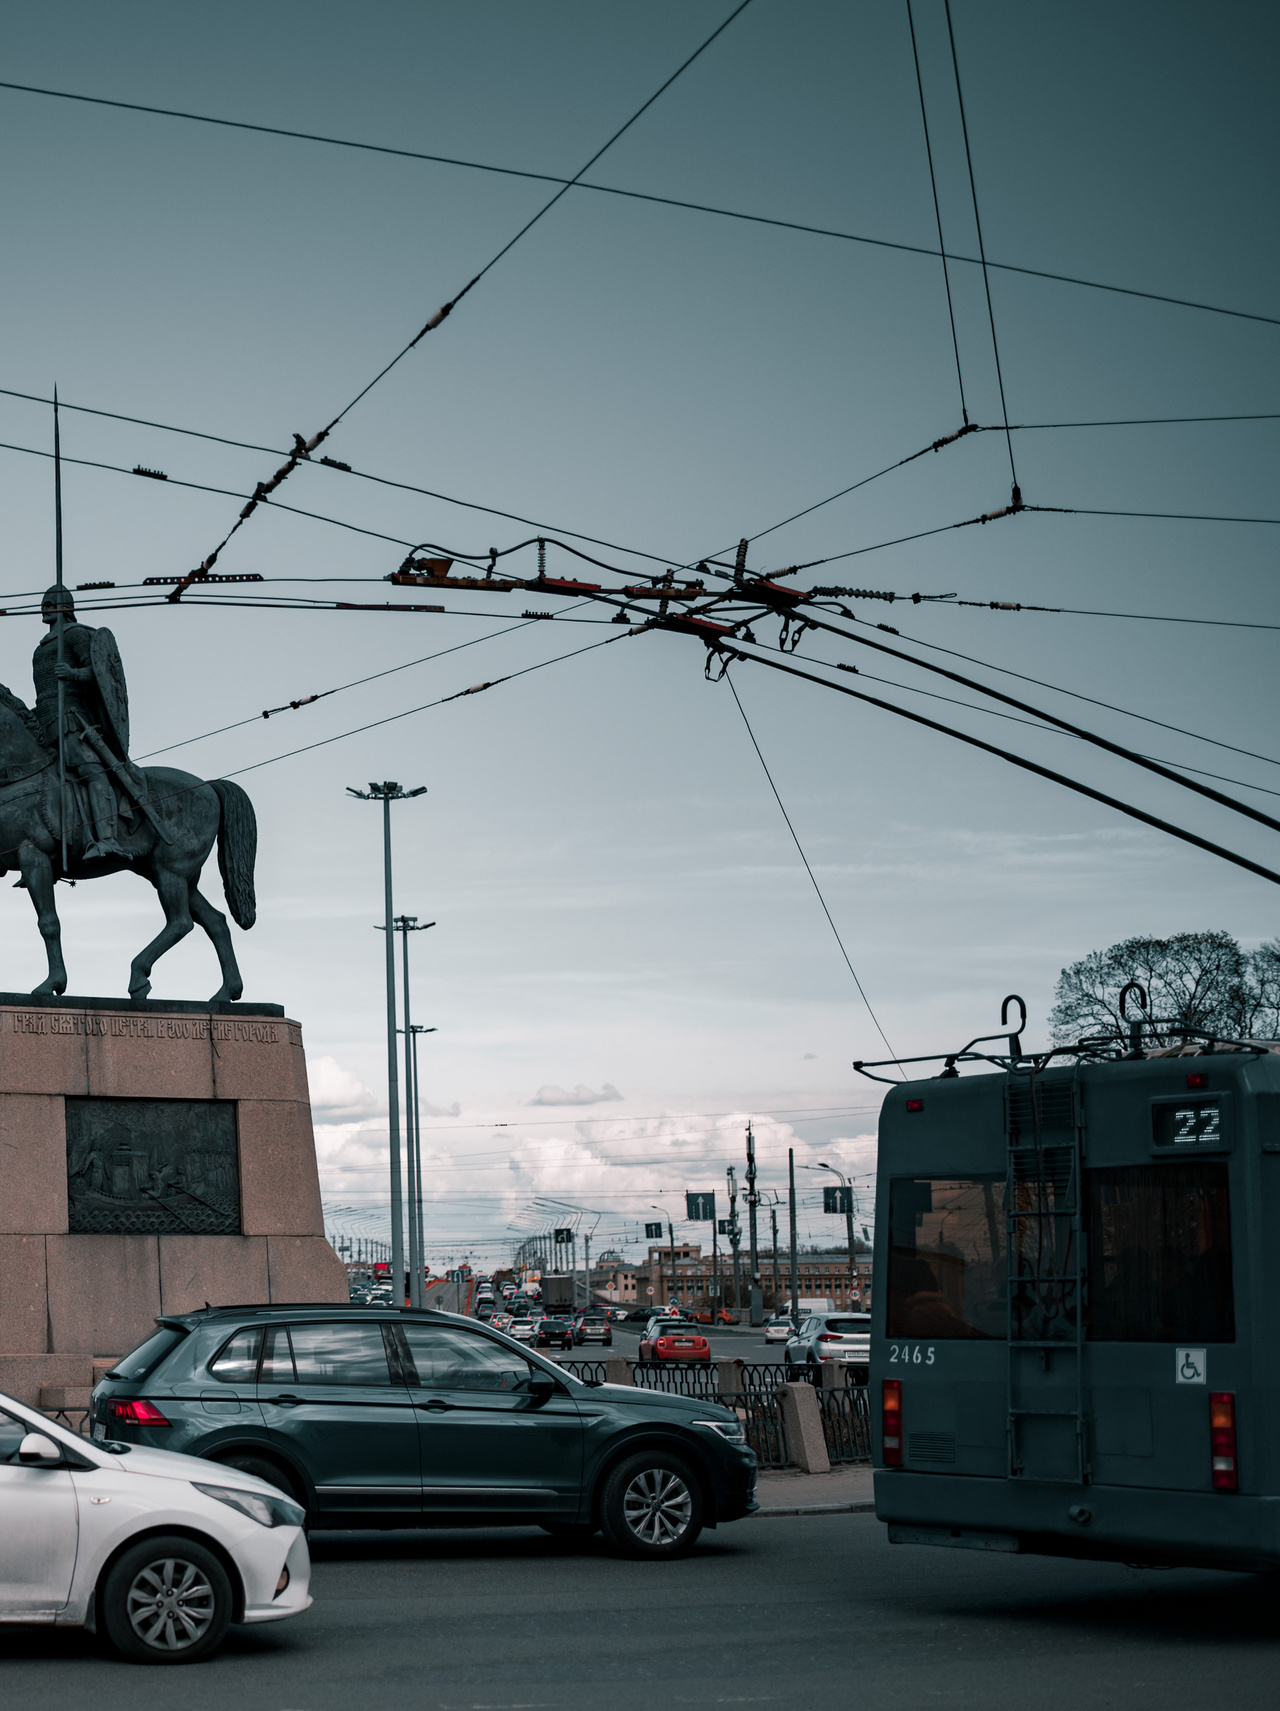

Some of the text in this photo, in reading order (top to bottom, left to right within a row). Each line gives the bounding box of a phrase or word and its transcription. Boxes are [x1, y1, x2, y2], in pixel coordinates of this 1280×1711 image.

[13, 1014, 47, 1035] ГРАД
[1173, 1108, 1220, 1144] 22
[889, 1344, 935, 1365] 2465
